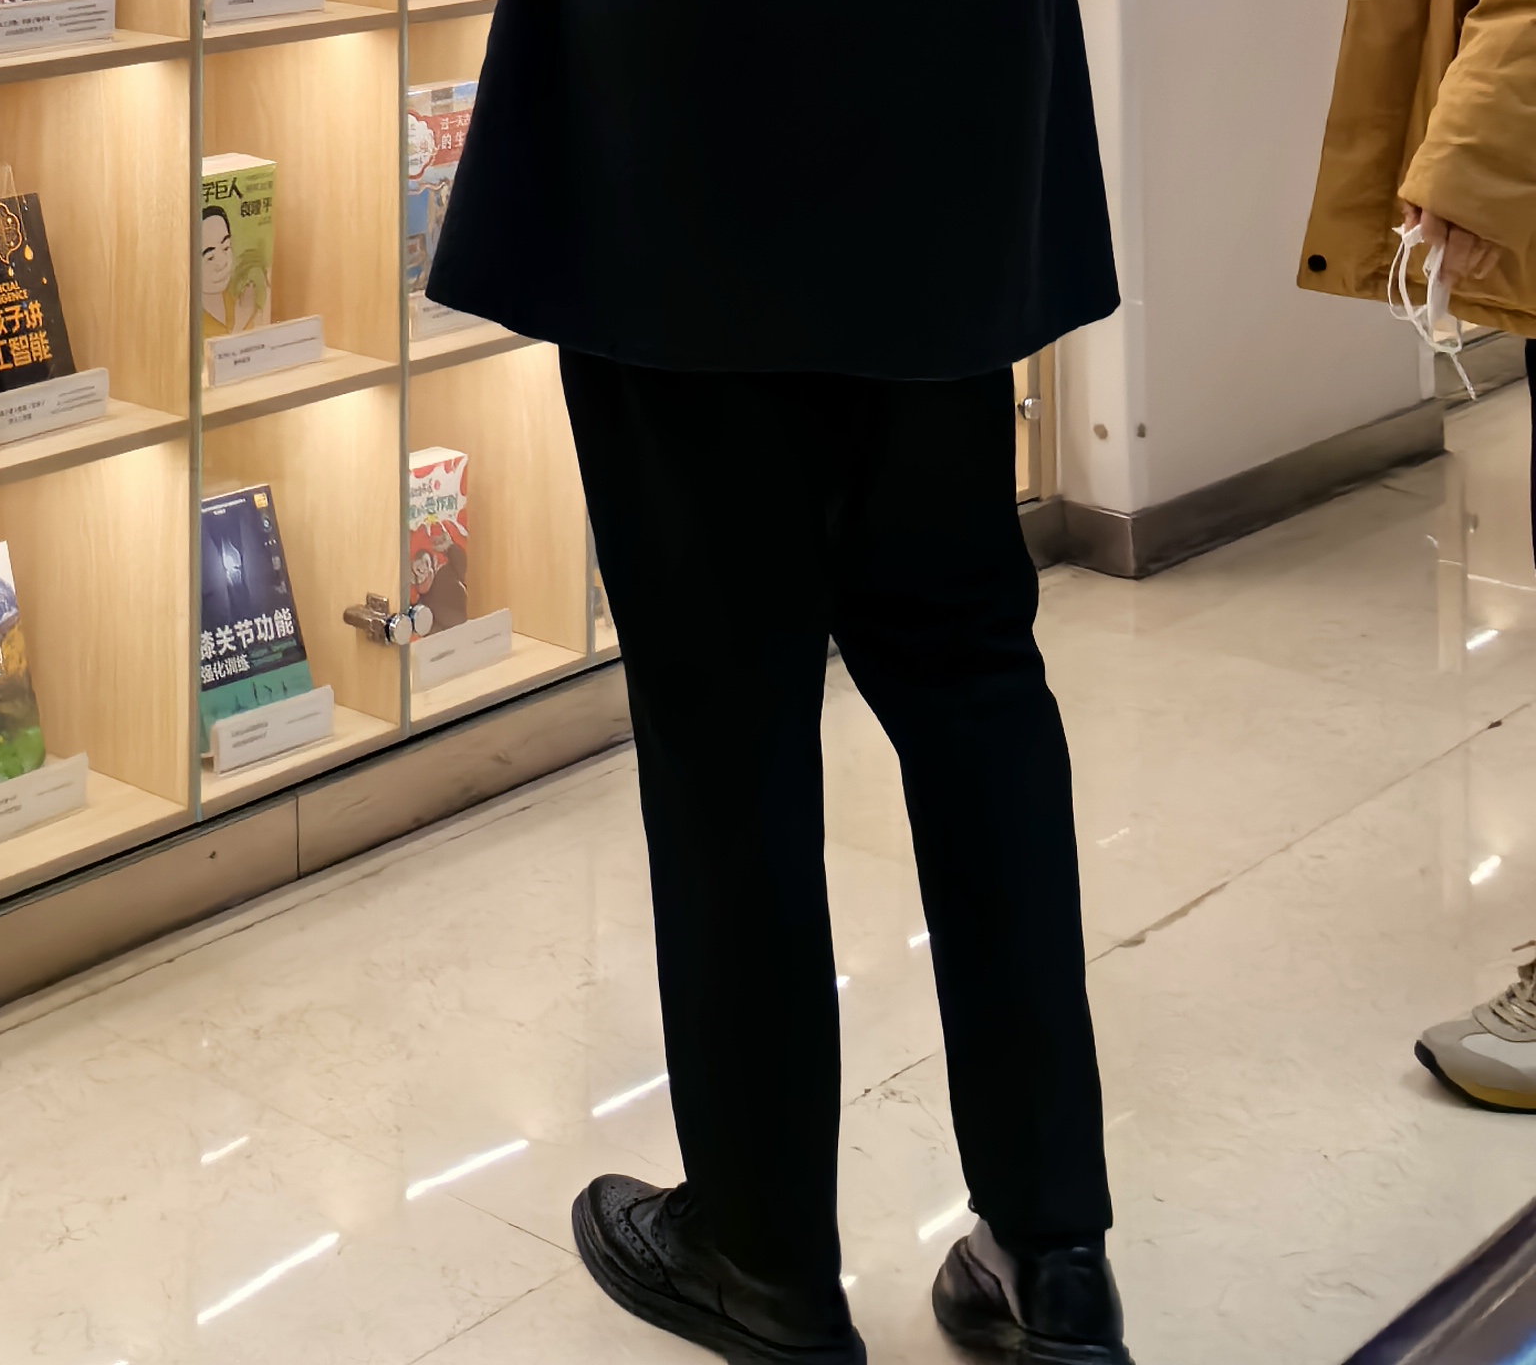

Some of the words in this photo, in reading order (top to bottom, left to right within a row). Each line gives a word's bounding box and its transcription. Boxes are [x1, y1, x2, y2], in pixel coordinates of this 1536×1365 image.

[201, 607, 295, 661] 膝关节功能
[201, 653, 251, 684] 强化训练
